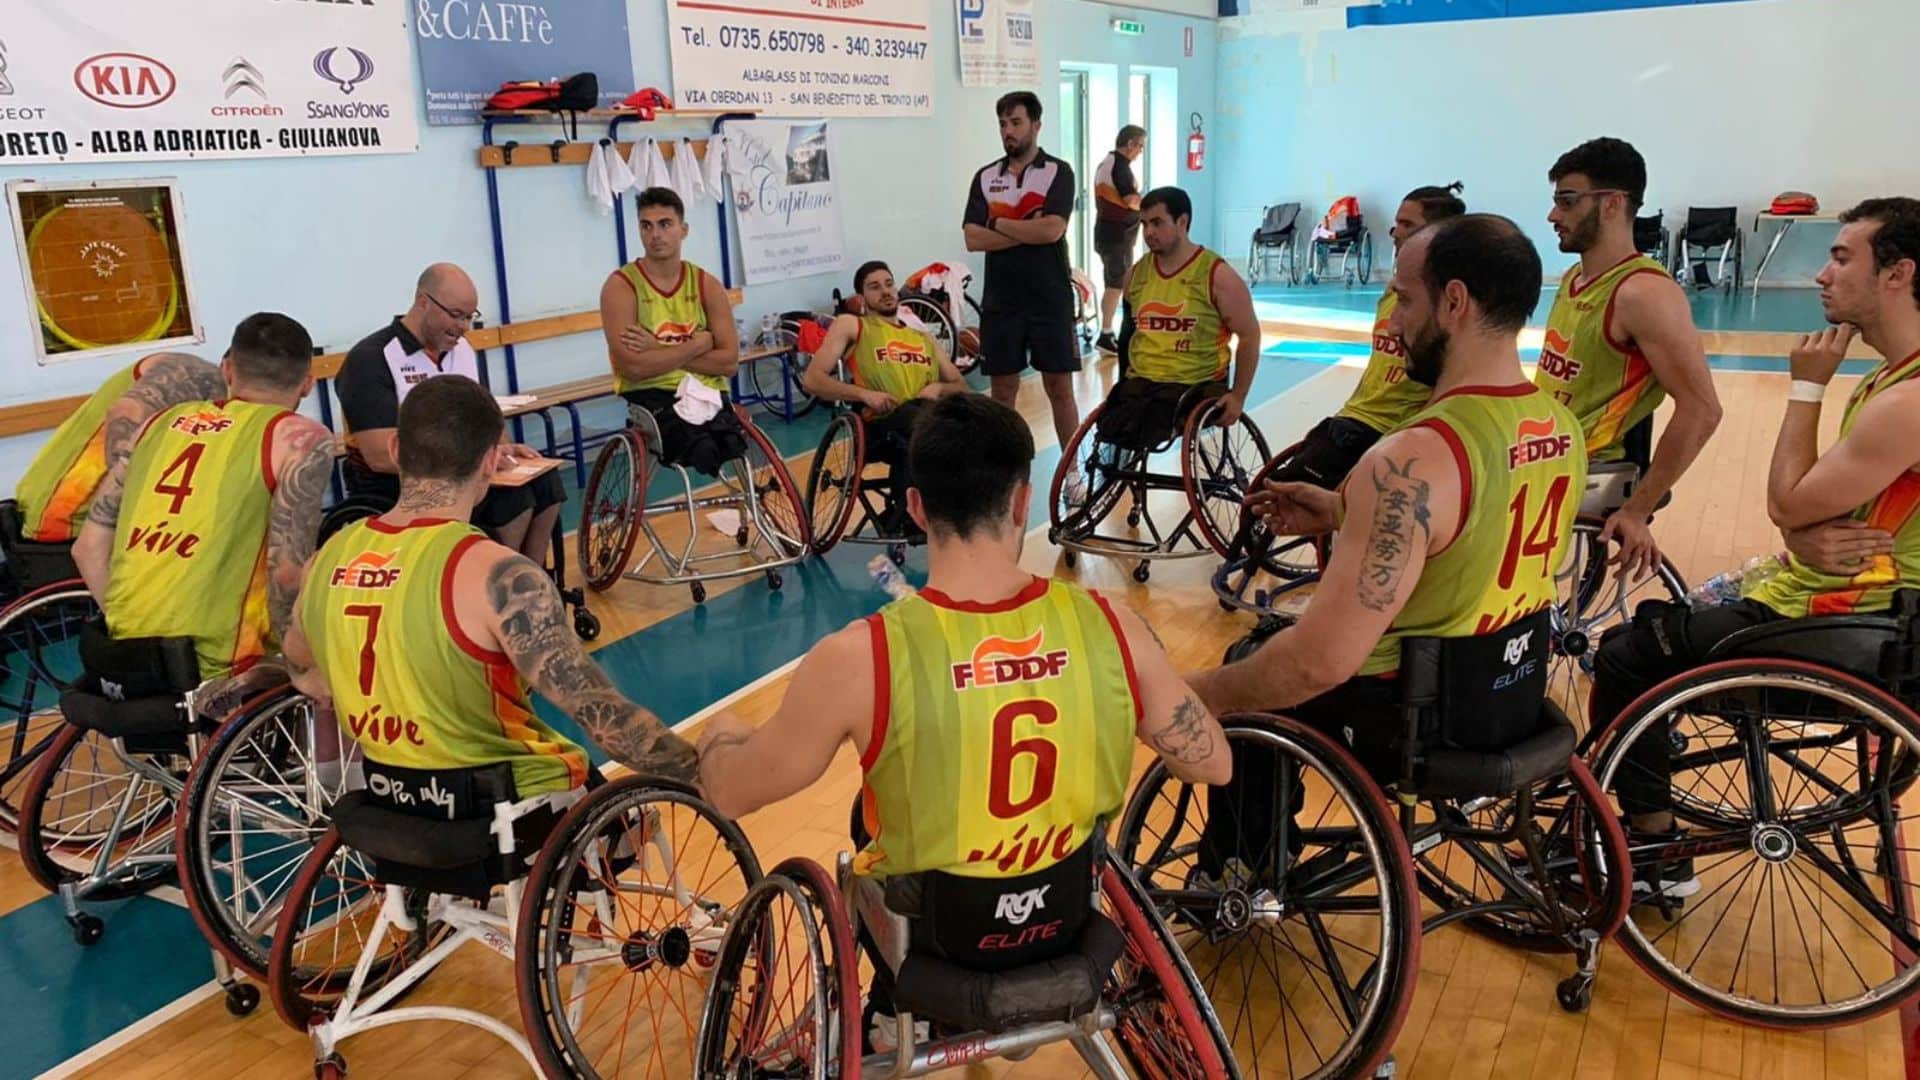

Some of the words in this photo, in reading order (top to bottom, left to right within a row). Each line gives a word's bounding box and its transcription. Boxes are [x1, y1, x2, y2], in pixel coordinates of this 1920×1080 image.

[681, 26, 711, 47] Tel.
[720, 25, 826, 54] 0735.650798
[845, 36, 928, 60] 340.3239447
[91, 65, 162, 96] KIA
[743, 69, 797, 83] ALBAGLASS
[800, 72, 811, 83] DI
[814, 72, 850, 84] TONINO
[685, 91, 706, 103] VIA
[711, 91, 760, 104] OBERDAN
[763, 92, 773, 104] 13
[790, 92, 810, 104] SAN
[813, 93, 862, 105] BENEDETTO
[864, 94, 879, 105] DEL
[91, 130, 149, 153] ALBA
[153, 128, 262, 152] ADRIATICA
[278, 127, 382, 149] GIULIANOVA
[1385, 365, 1405, 384] 10
[1508, 434, 1572, 471] FEDDF
[154, 442, 207, 515] 4
[1497, 474, 1572, 591] 14
[330, 566, 401, 588] FEDDF
[343, 604, 383, 697] 7
[951, 650, 1069, 691] FEDDF
[1492, 659, 1538, 690] ELITE
[988, 699, 1059, 820] 6
[977, 919, 1063, 949] ELITE
